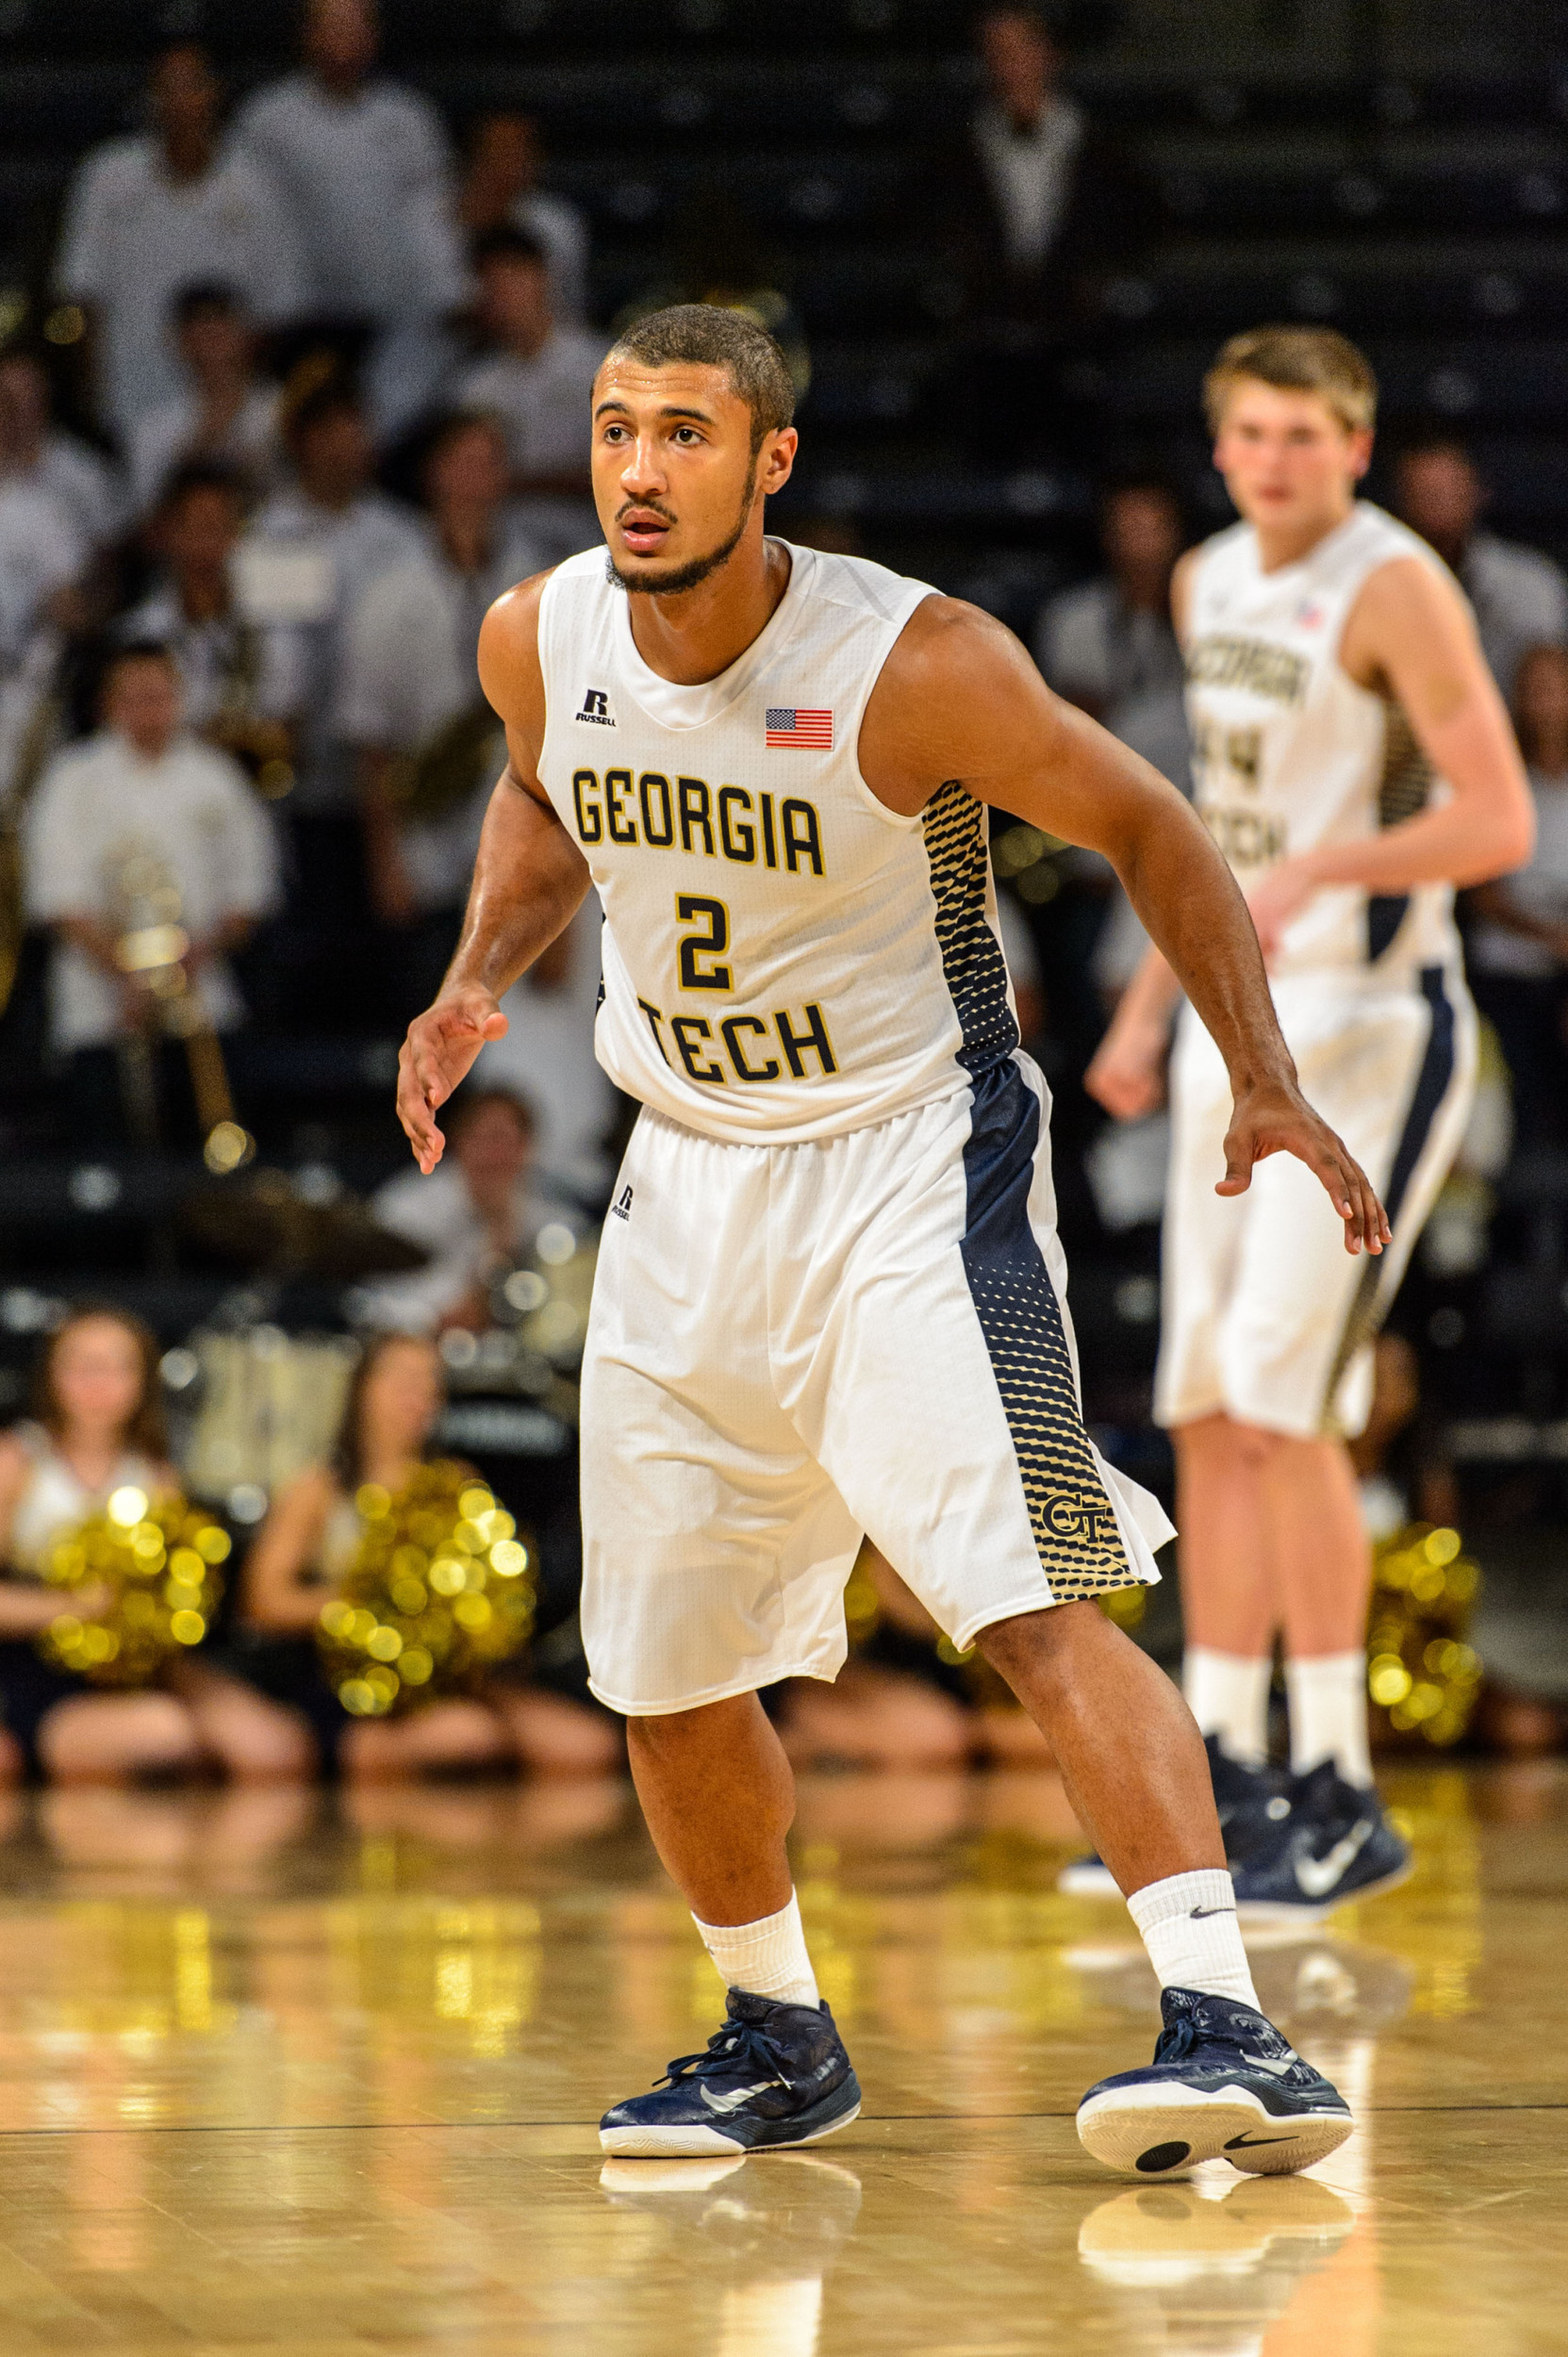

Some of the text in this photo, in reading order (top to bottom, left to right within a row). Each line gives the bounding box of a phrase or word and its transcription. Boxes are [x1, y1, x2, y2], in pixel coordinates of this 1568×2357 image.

[575, 712, 617, 727] RUSSELL
[583, 688, 608, 716] R
[572, 767, 827, 878] GEORGIA
[674, 892, 734, 993] 2
[636, 1002, 839, 1085] TECH
[619, 1184, 633, 1211] R
[1041, 1492, 1107, 1544] GT
